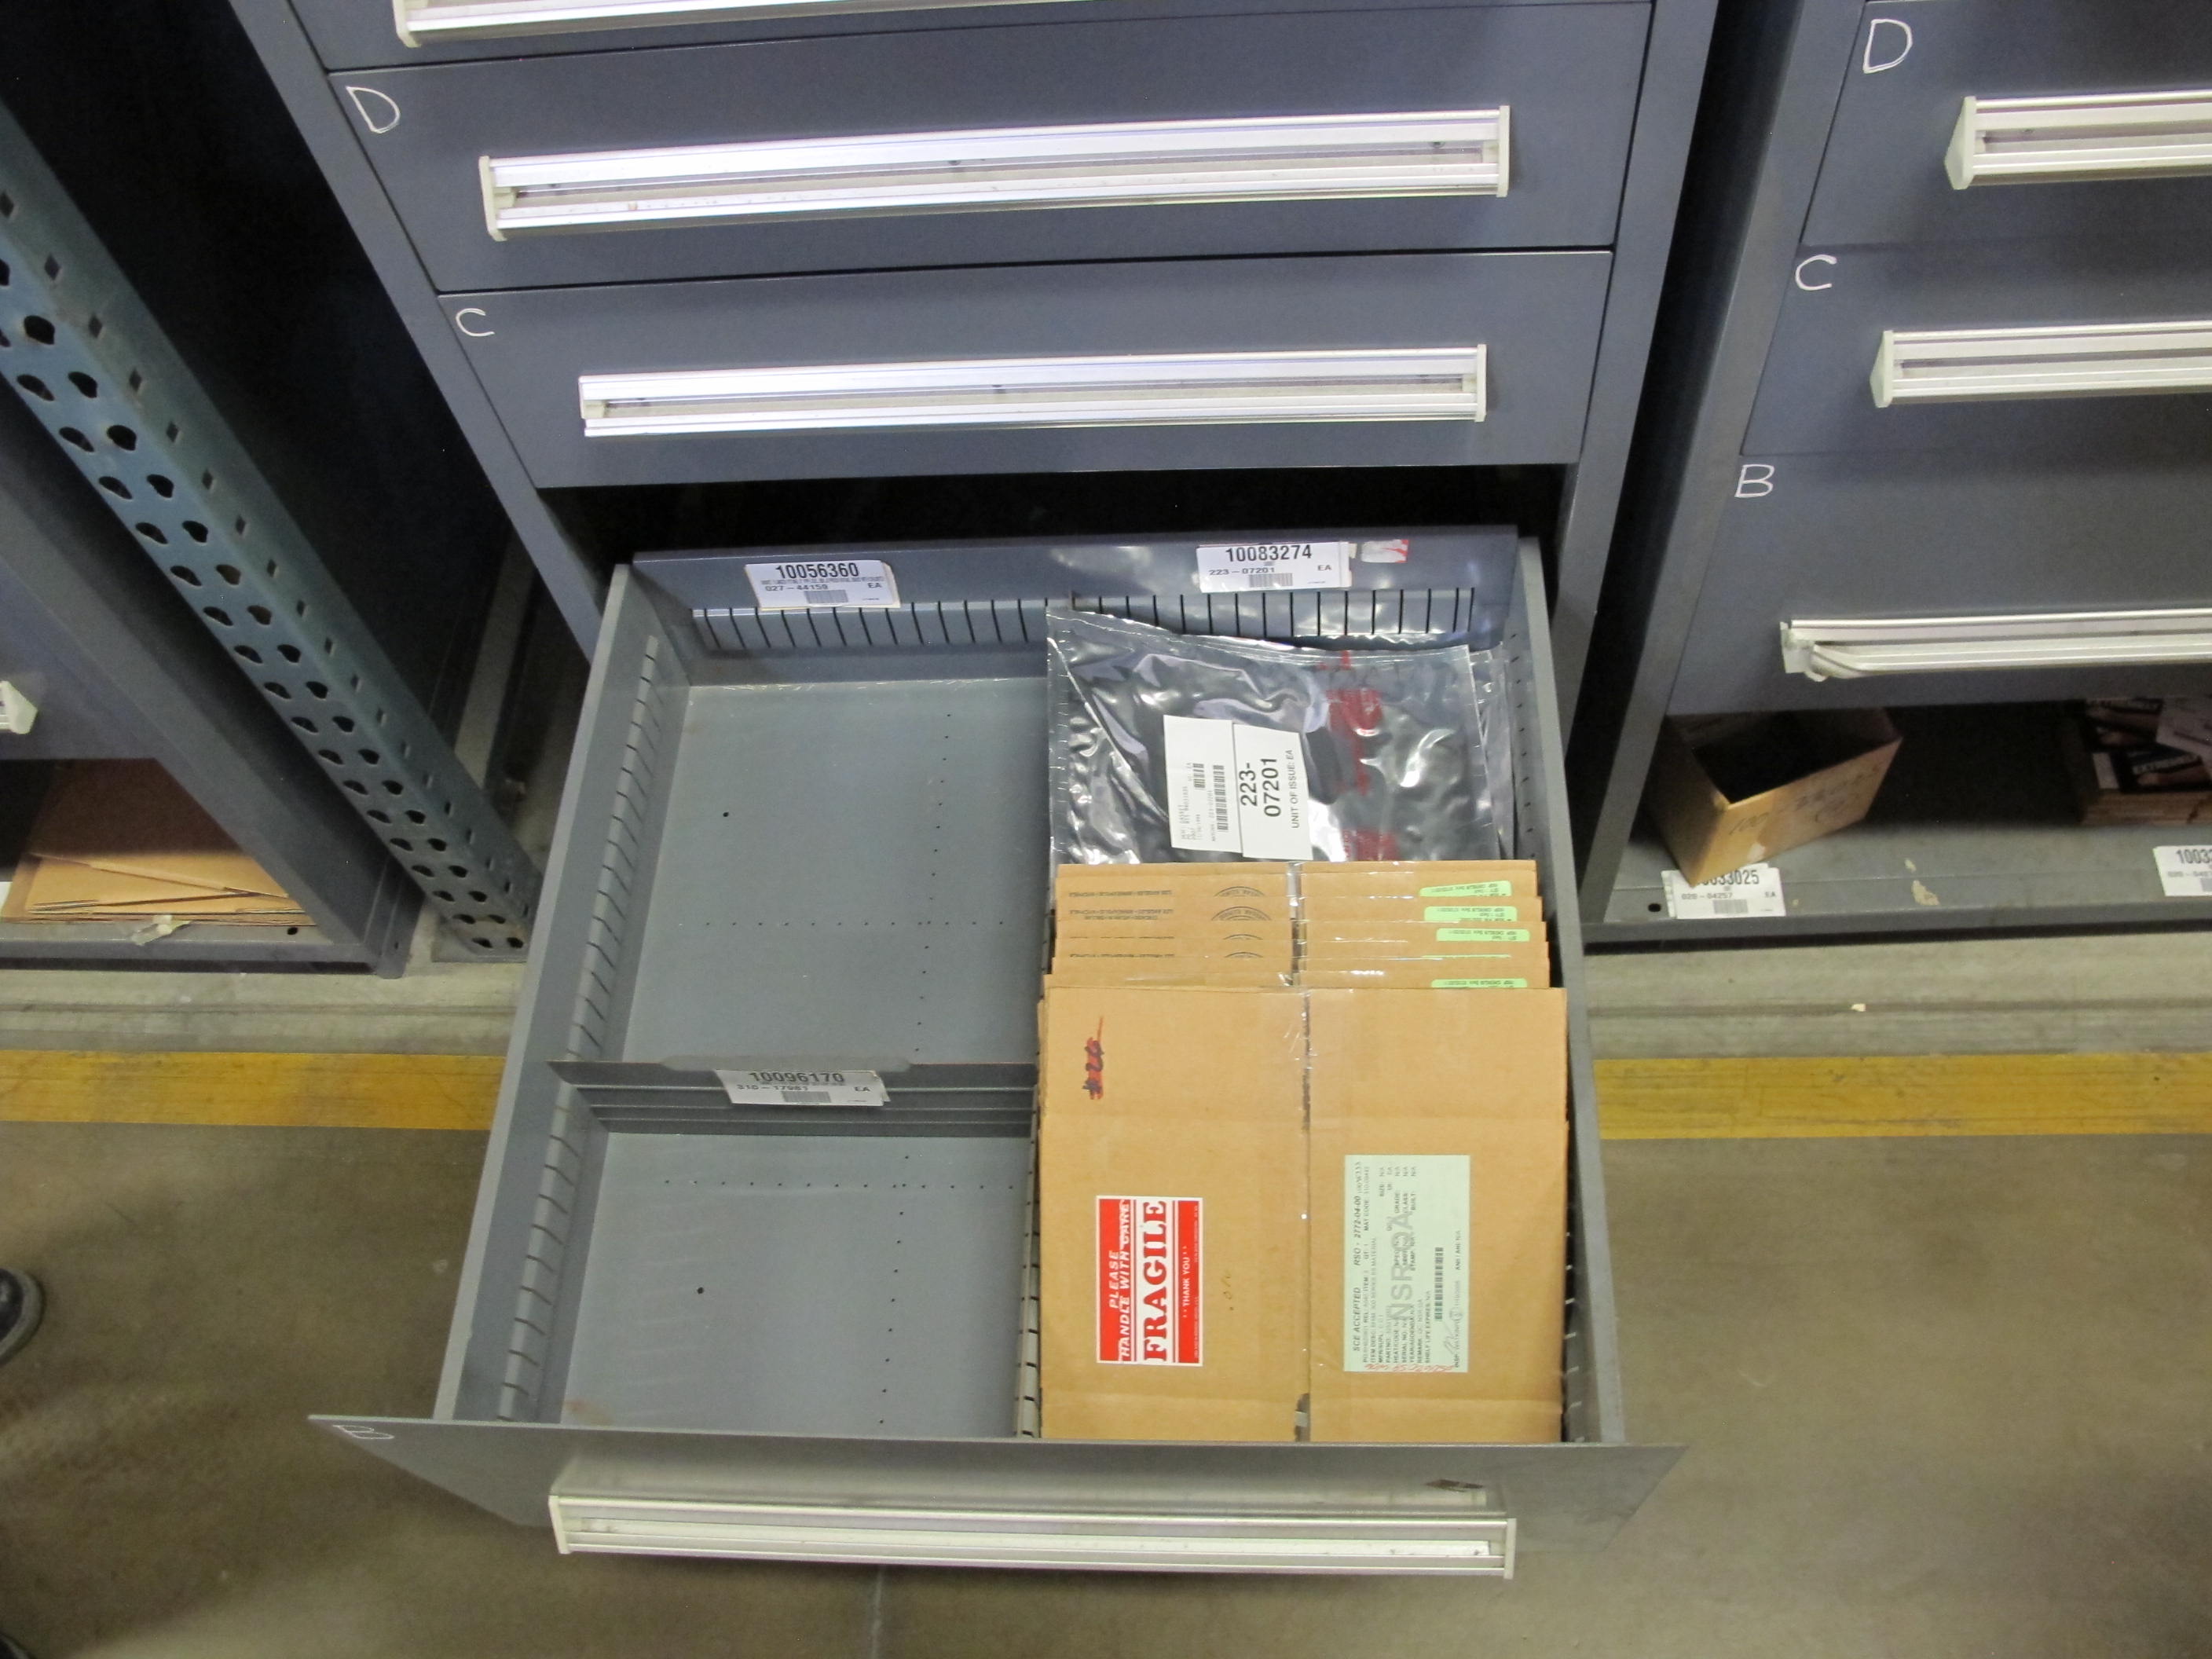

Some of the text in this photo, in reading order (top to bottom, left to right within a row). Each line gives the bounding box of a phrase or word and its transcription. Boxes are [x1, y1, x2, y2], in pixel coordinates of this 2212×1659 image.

[1862, 18, 1913, 74] D
[346, 86, 401, 134] D
[1796, 255, 1837, 291] C
[456, 308, 495, 337] C
[1734, 463, 1774, 498] B
[776, 562, 859, 579] 10056360
[1225, 545, 1312, 562] 10083274
[1240, 763, 1257, 806] 223-
[1261, 758, 1280, 817] 07201
[1286, 749, 1299, 828] UNIT OF ISSUE: EA
[749, 1072, 844, 1082] 10096170
[1109, 1250, 1119, 1309] PLEASE
[1120, 1251, 1130, 1288] WITH
[1144, 1201, 1166, 1361] FRAGILE
[1120, 1296, 1130, 1357] HANDLE
